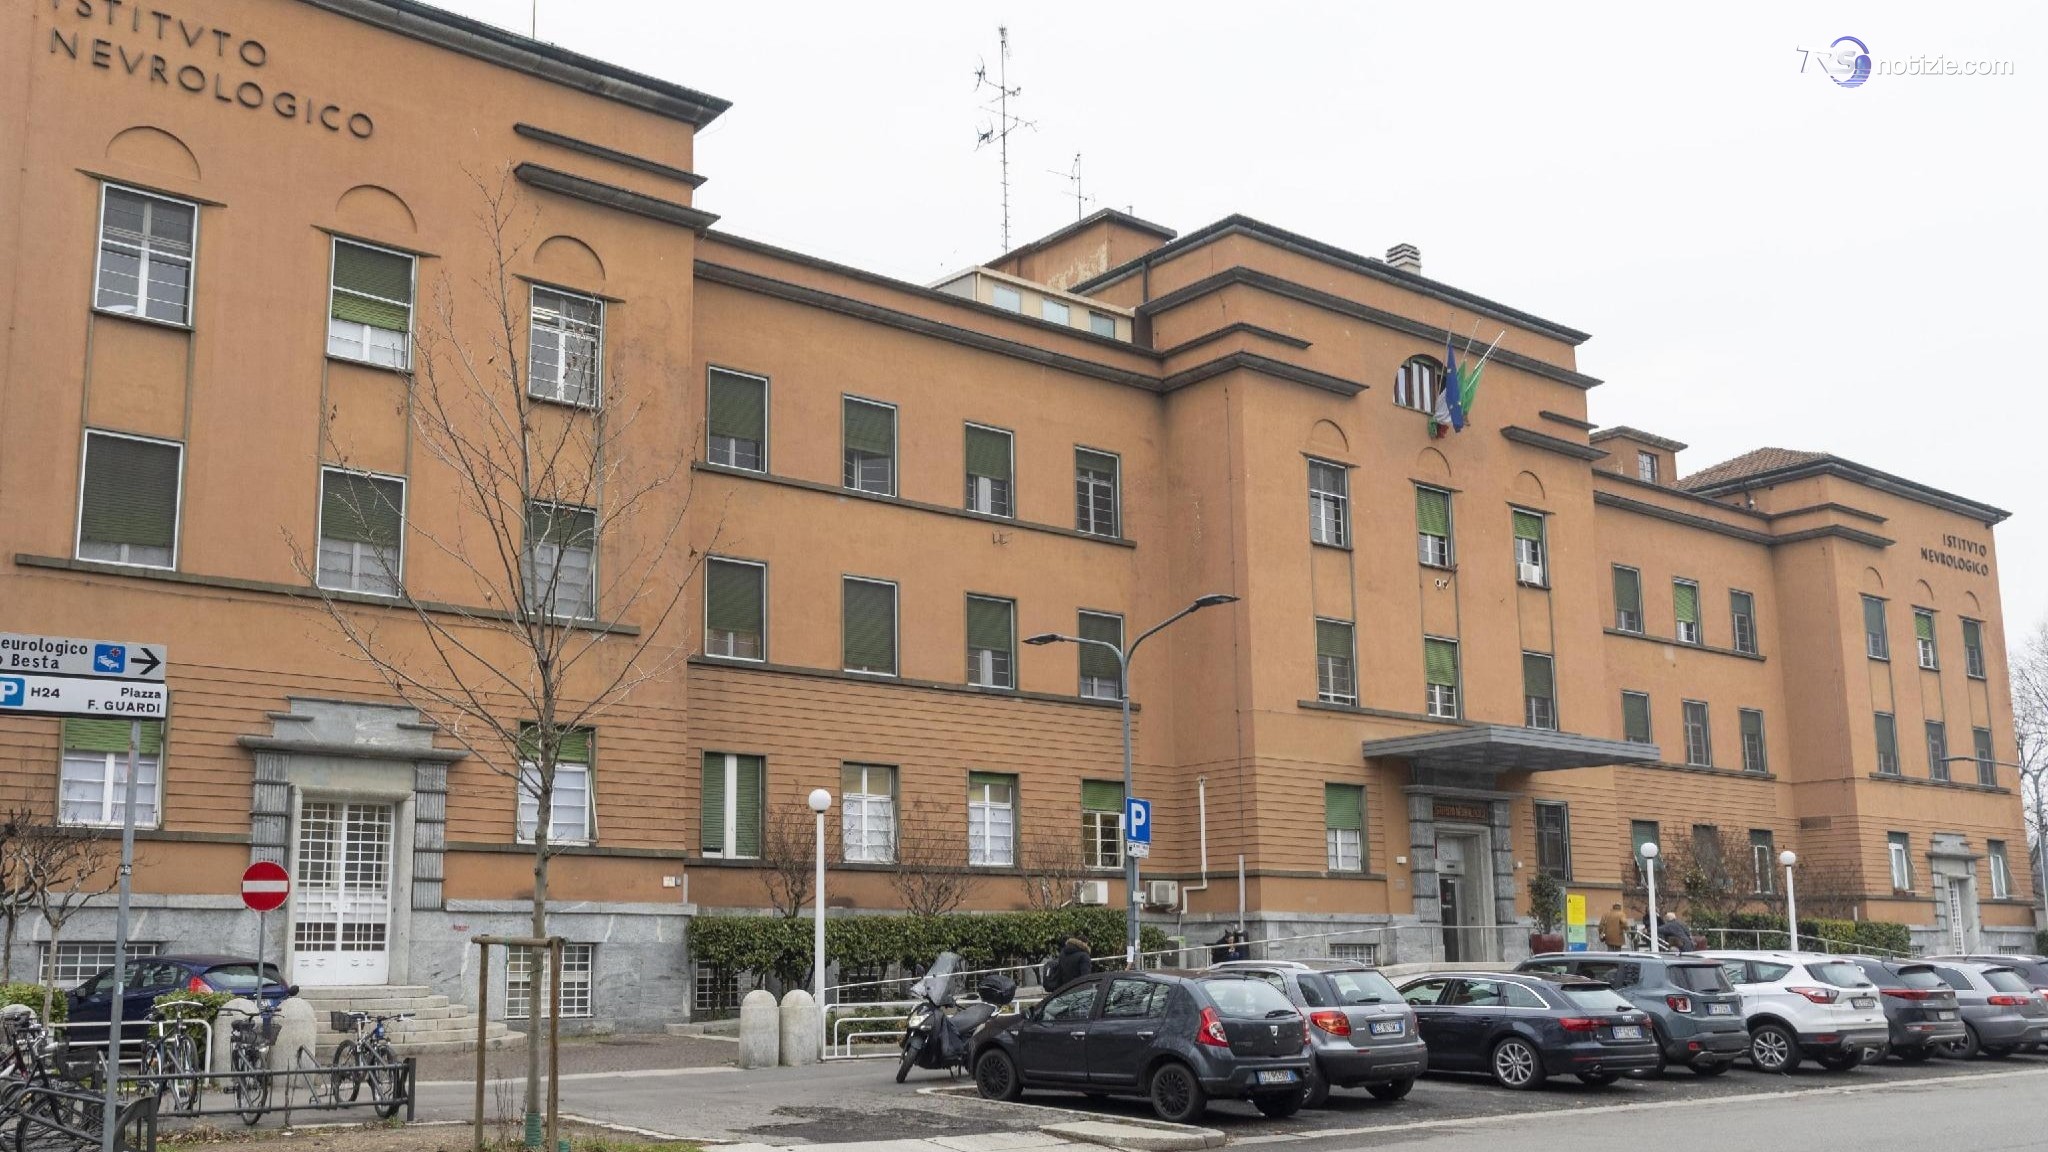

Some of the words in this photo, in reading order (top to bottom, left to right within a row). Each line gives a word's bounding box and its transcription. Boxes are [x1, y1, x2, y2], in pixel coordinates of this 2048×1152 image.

[50, 27, 374, 139] NEVROLOGICO
[1942, 533, 1987, 557] ISTITVTO
[1920, 547, 1989, 576] NEVROLOGICO
[11, 653, 59, 670] Besta
[30, 687, 61, 699] H24
[120, 687, 162, 700] Piazza
[87, 699, 99, 710] F.
[104, 700, 161, 714] GUARDI
[1131, 803, 1146, 837] P
